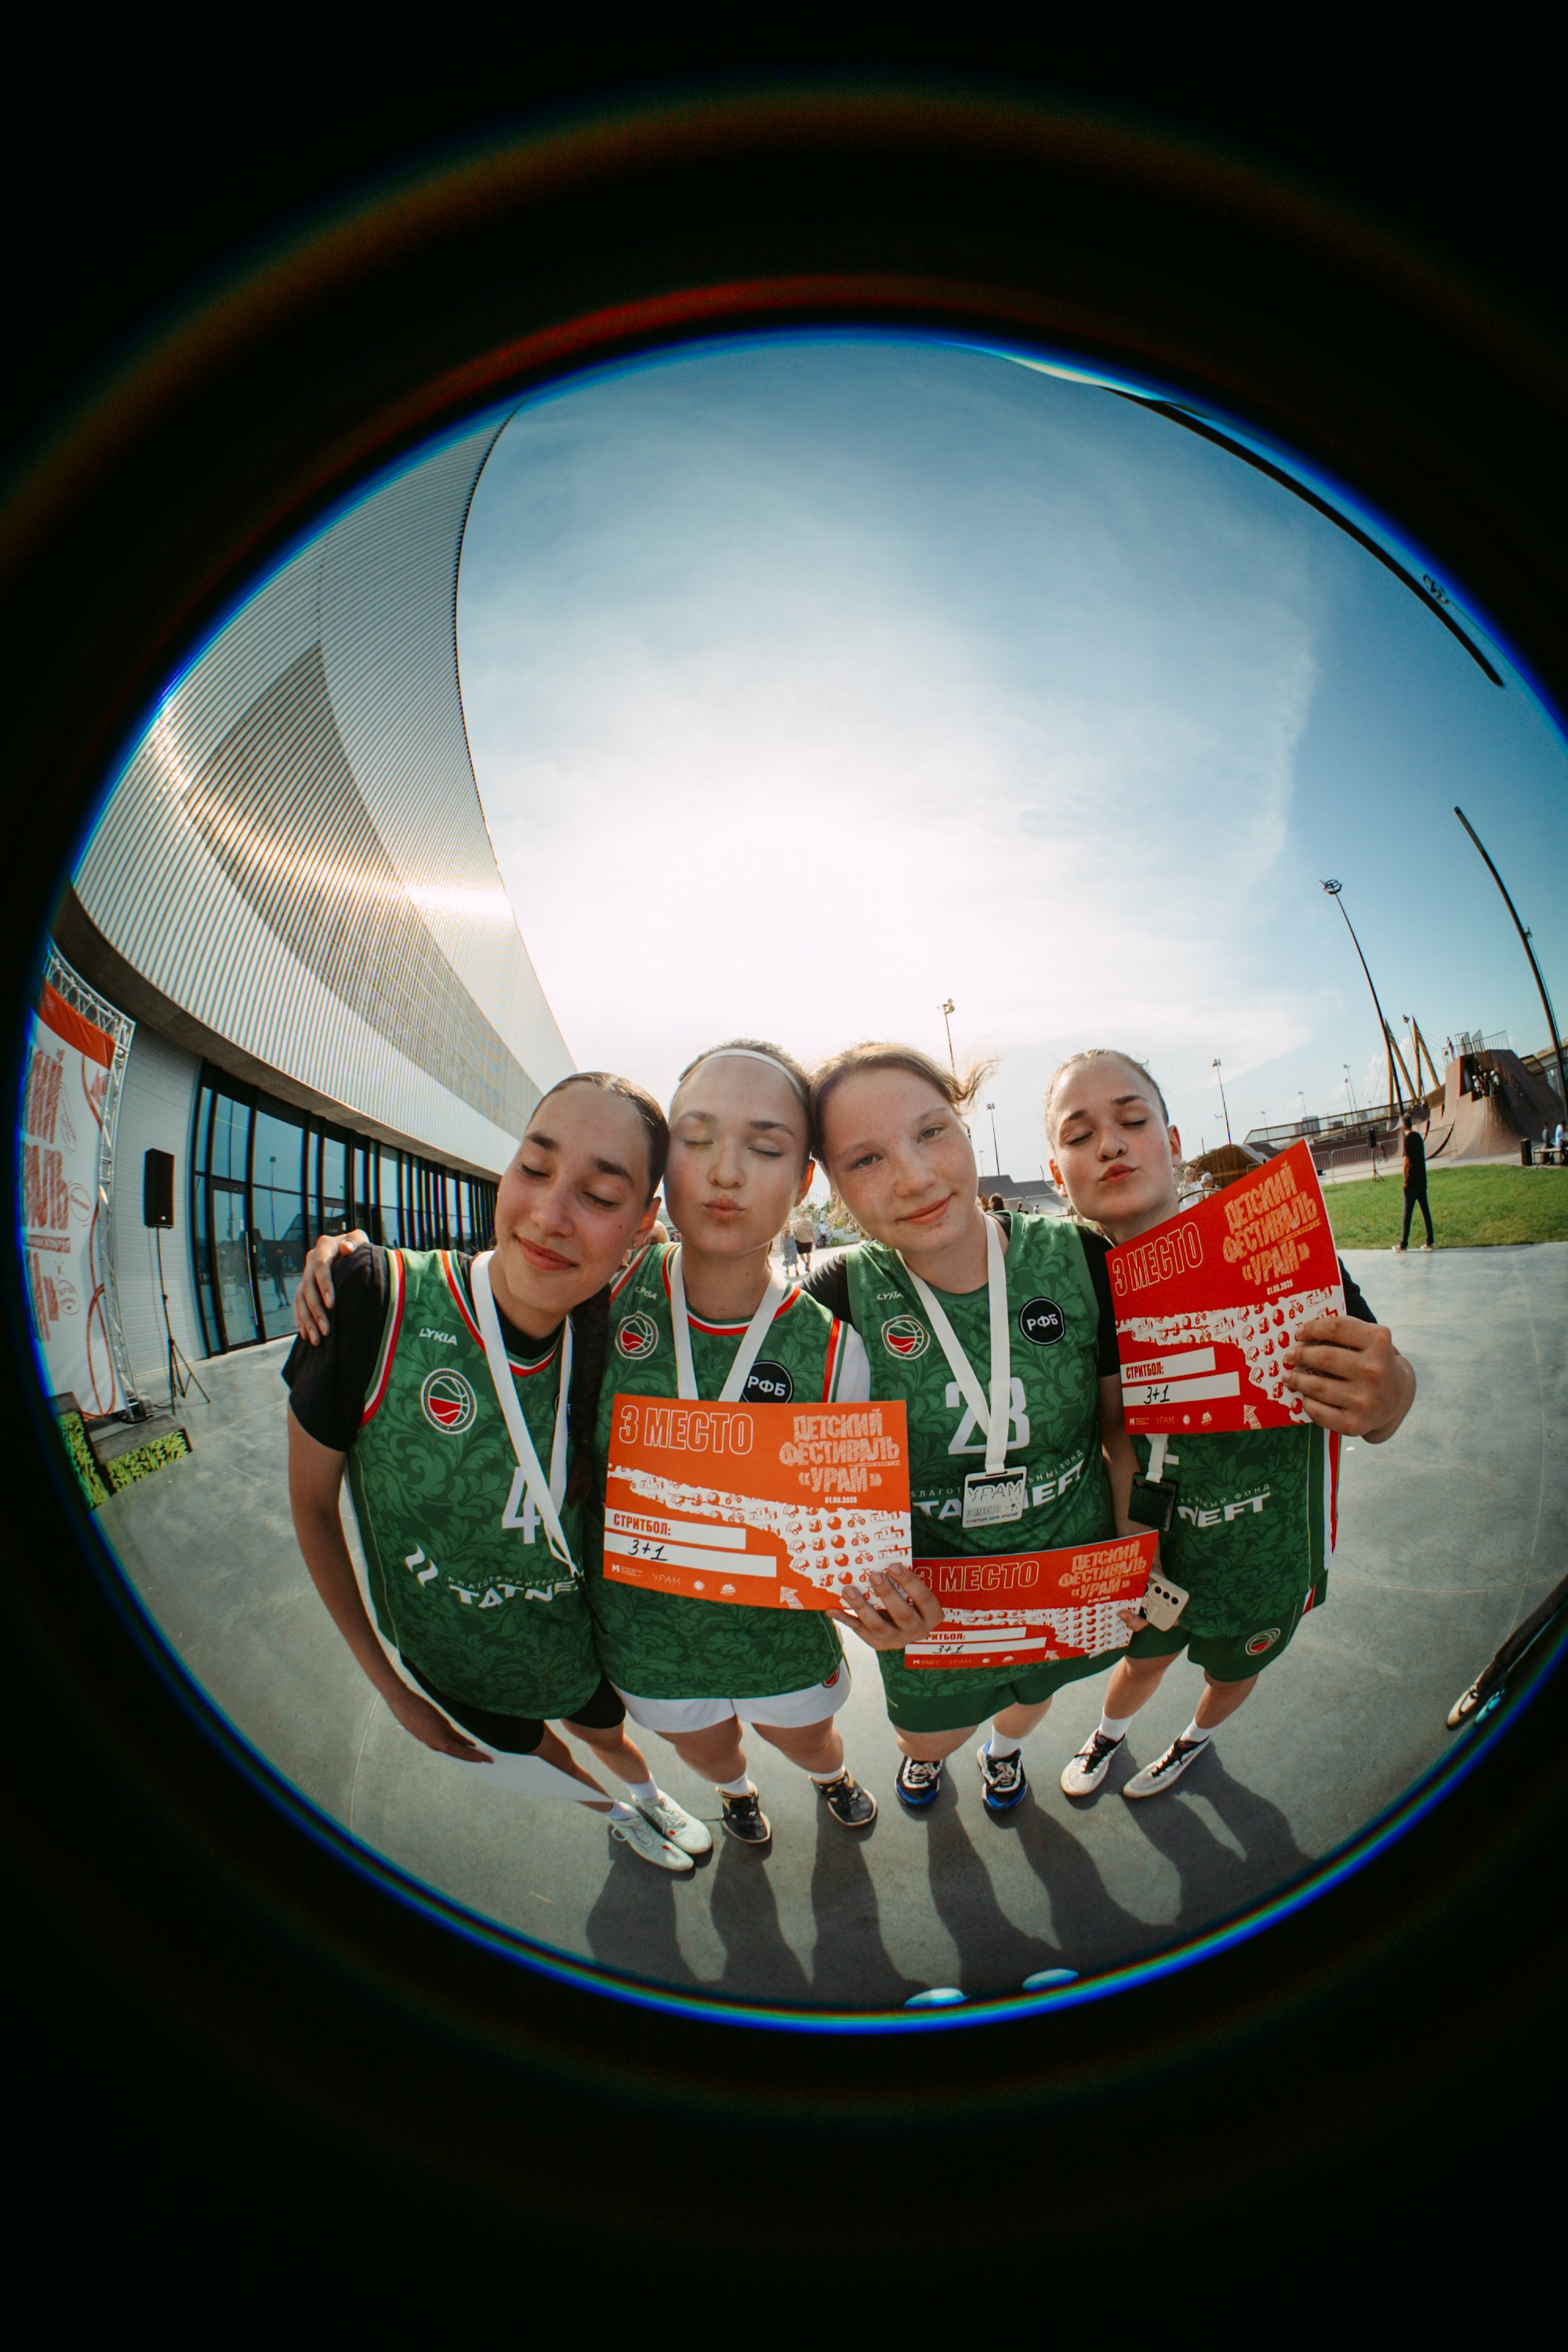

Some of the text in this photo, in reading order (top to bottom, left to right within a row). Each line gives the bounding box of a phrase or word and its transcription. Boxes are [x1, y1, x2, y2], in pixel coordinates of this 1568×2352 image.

[1223, 1160, 1298, 1235] ДЕТСКИЙ
[1222, 1191, 1318, 1264] ФЕСТИВАЛЬ
[1112, 1221, 1203, 1297] 3 МЕСТО
[1242, 1240, 1310, 1286] «УРАМ»
[1026, 1313, 1059, 1331] РФБ
[419, 1327, 458, 1346] LYKIA
[1126, 1361, 1164, 1380] СТРИТБОЛ:
[747, 1375, 786, 1398] РФБ
[1143, 1384, 1171, 1405] 3+1
[619, 1405, 753, 1456] 3 МЕСТО
[793, 1408, 883, 1443] ДЕТСКИЙ
[779, 1436, 900, 1467] ФЕСТИВАЛЬ
[797, 1467, 883, 1493] «УРАМ»
[967, 1482, 1022, 1502] УРАМ
[1235, 1483, 1270, 1500] ФОНД
[501, 1466, 542, 1544] 4
[613, 1513, 671, 1536] СТРИТБОЛ:
[628, 1539, 669, 1562] 3+1
[1071, 1540, 1141, 1573] ДЕТСКИЙ
[652, 1572, 681, 1586] УРАМ
[938, 1560, 1040, 1592] МЕСТО
[1058, 1556, 1147, 1588] ФЕСТИВАЛЬ
[448, 1579, 579, 1609] TATNE
[926, 1632, 966, 1641] РИТБОЛ:
